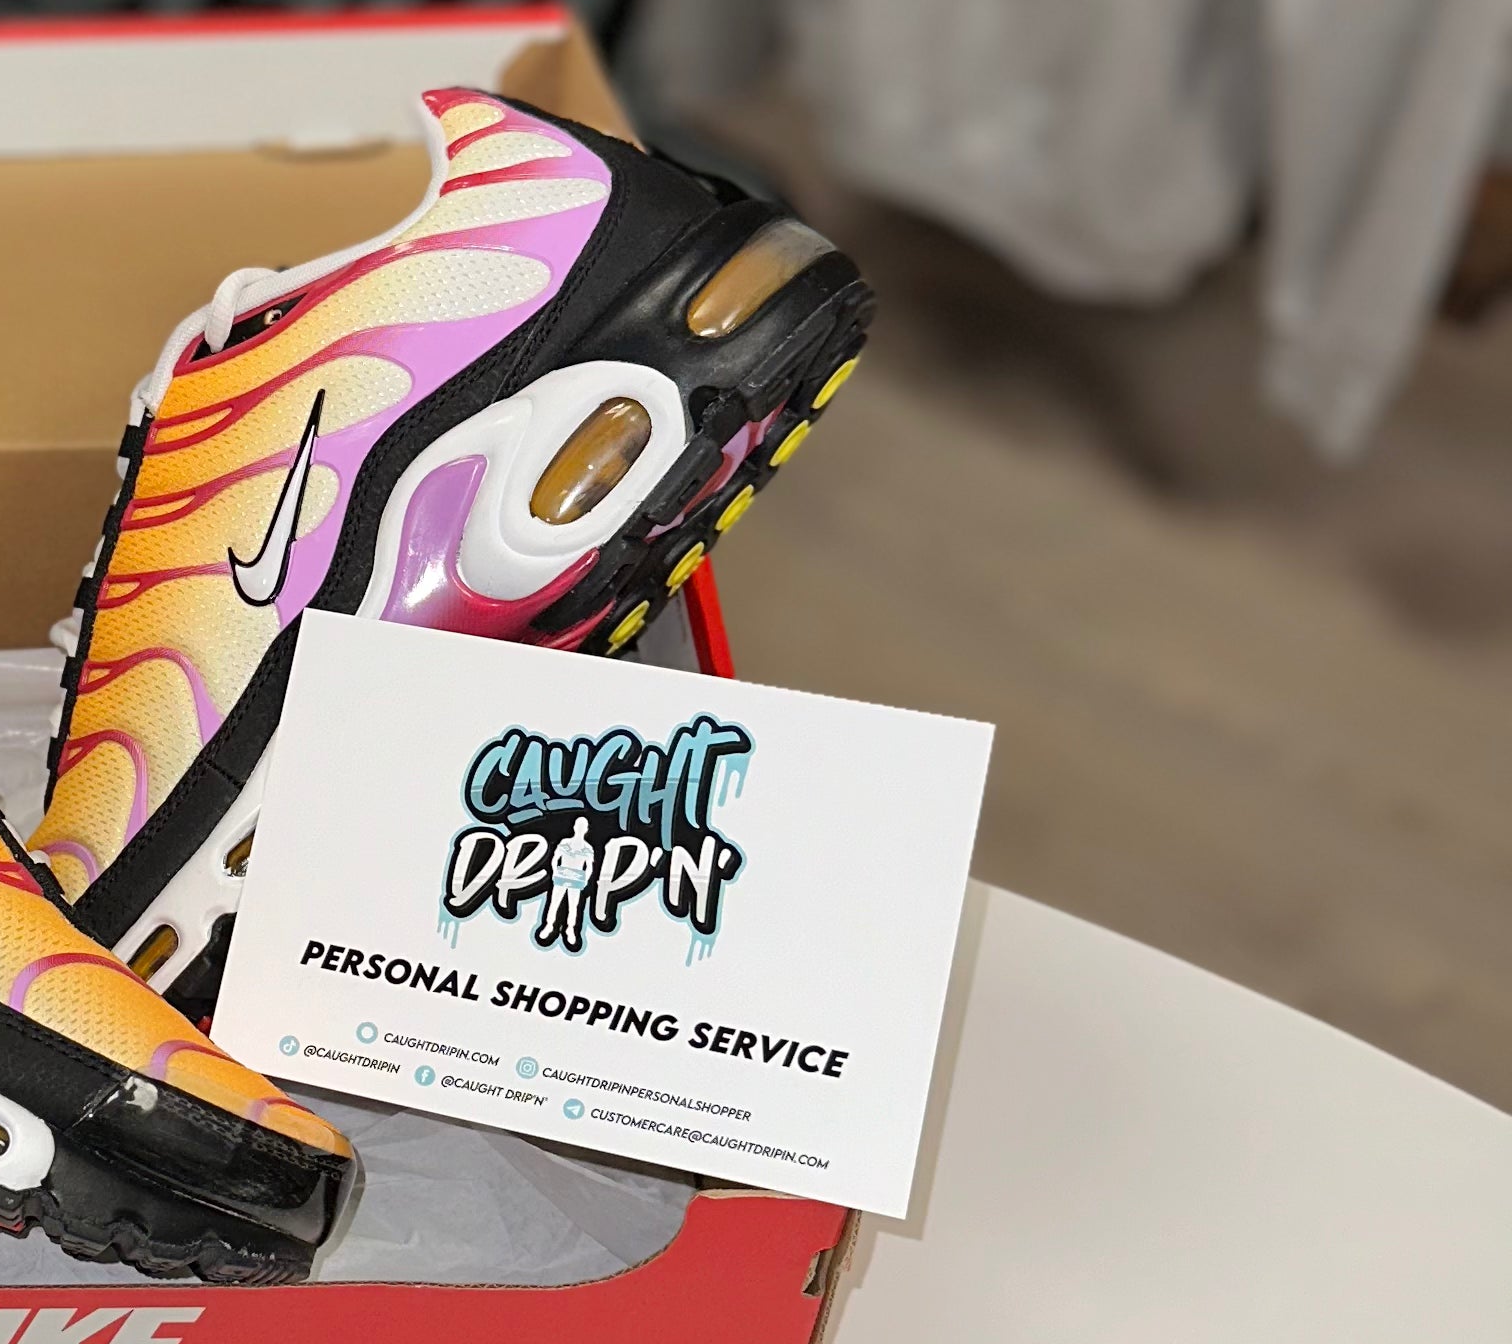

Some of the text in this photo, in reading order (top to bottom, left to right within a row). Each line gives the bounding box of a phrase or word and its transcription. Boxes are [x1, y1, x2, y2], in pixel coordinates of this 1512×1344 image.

[463, 716, 750, 852] CAUGHT
[301, 941, 849, 1077] PERSONAL SHOPPING SERVICE
[304, 1045, 400, 1073] @CAUGHTDRIPIN
[384, 1033, 499, 1066] CAUGHTDRIPIN.COM
[441, 1076, 504, 1096] @CAUGHT
[543, 1068, 751, 1121] CAUGHTDRIPINPERSONALSHOPPER
[591, 1109, 829, 1169] CUSTOMERCARE@CAUGHTDRIPIN.COM
